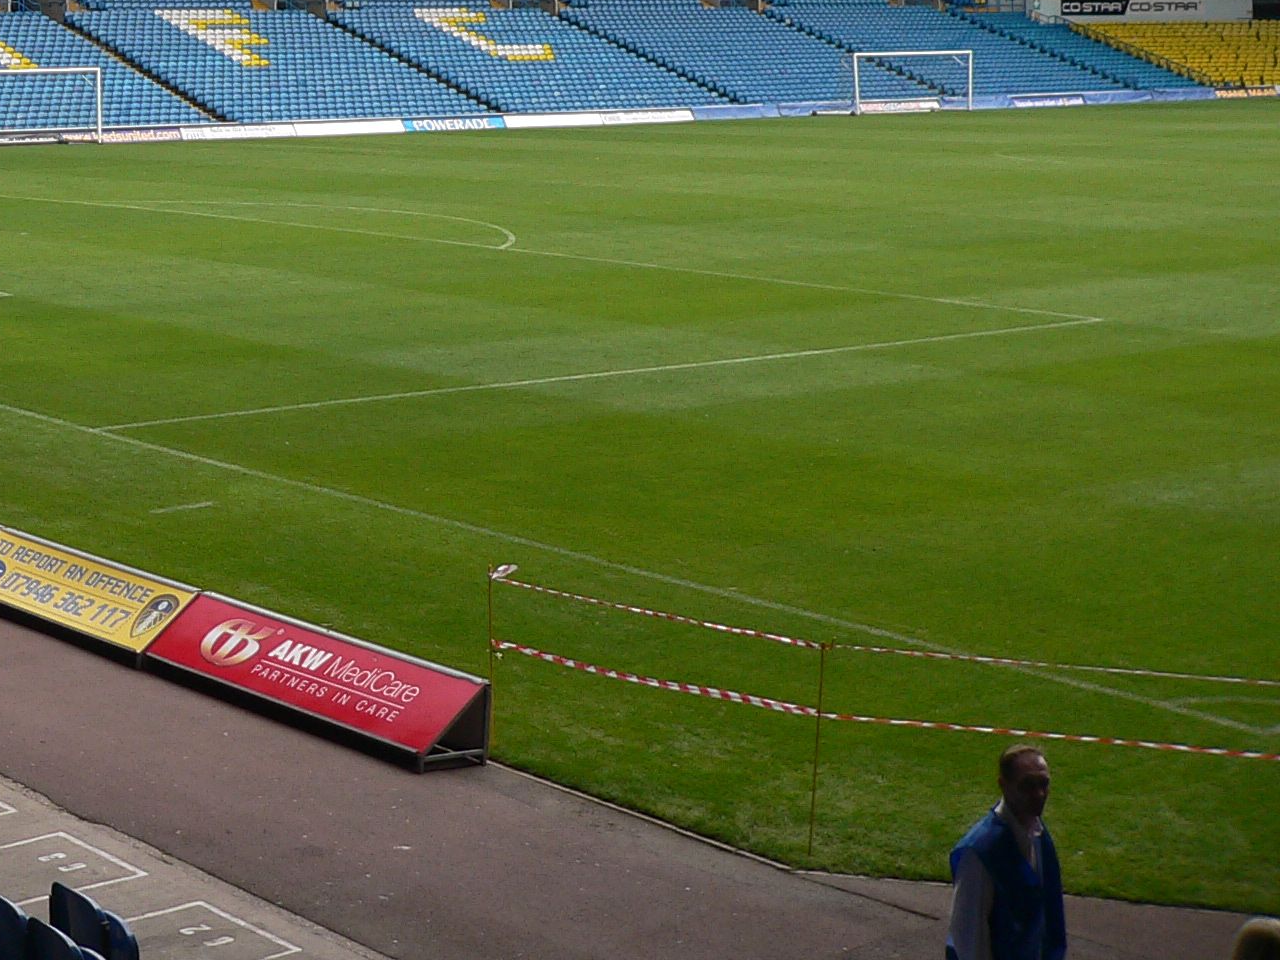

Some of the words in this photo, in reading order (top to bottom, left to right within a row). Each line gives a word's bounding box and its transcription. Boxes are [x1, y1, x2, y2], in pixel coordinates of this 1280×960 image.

[412, 117, 496, 131] POWERADE
[0, 571, 60, 605] 07946
[53, 590, 93, 616] 362
[89, 602, 132, 628] 117
[14, 545, 67, 573] REPORT
[62, 561, 91, 582] AN
[85, 571, 155, 604] OFFENCE
[250, 663, 328, 698] PARTNERS
[331, 690, 350, 706] IN
[355, 699, 400, 722] CARE
[268, 639, 333, 671] AKW
[323, 656, 420, 703] MediCare
